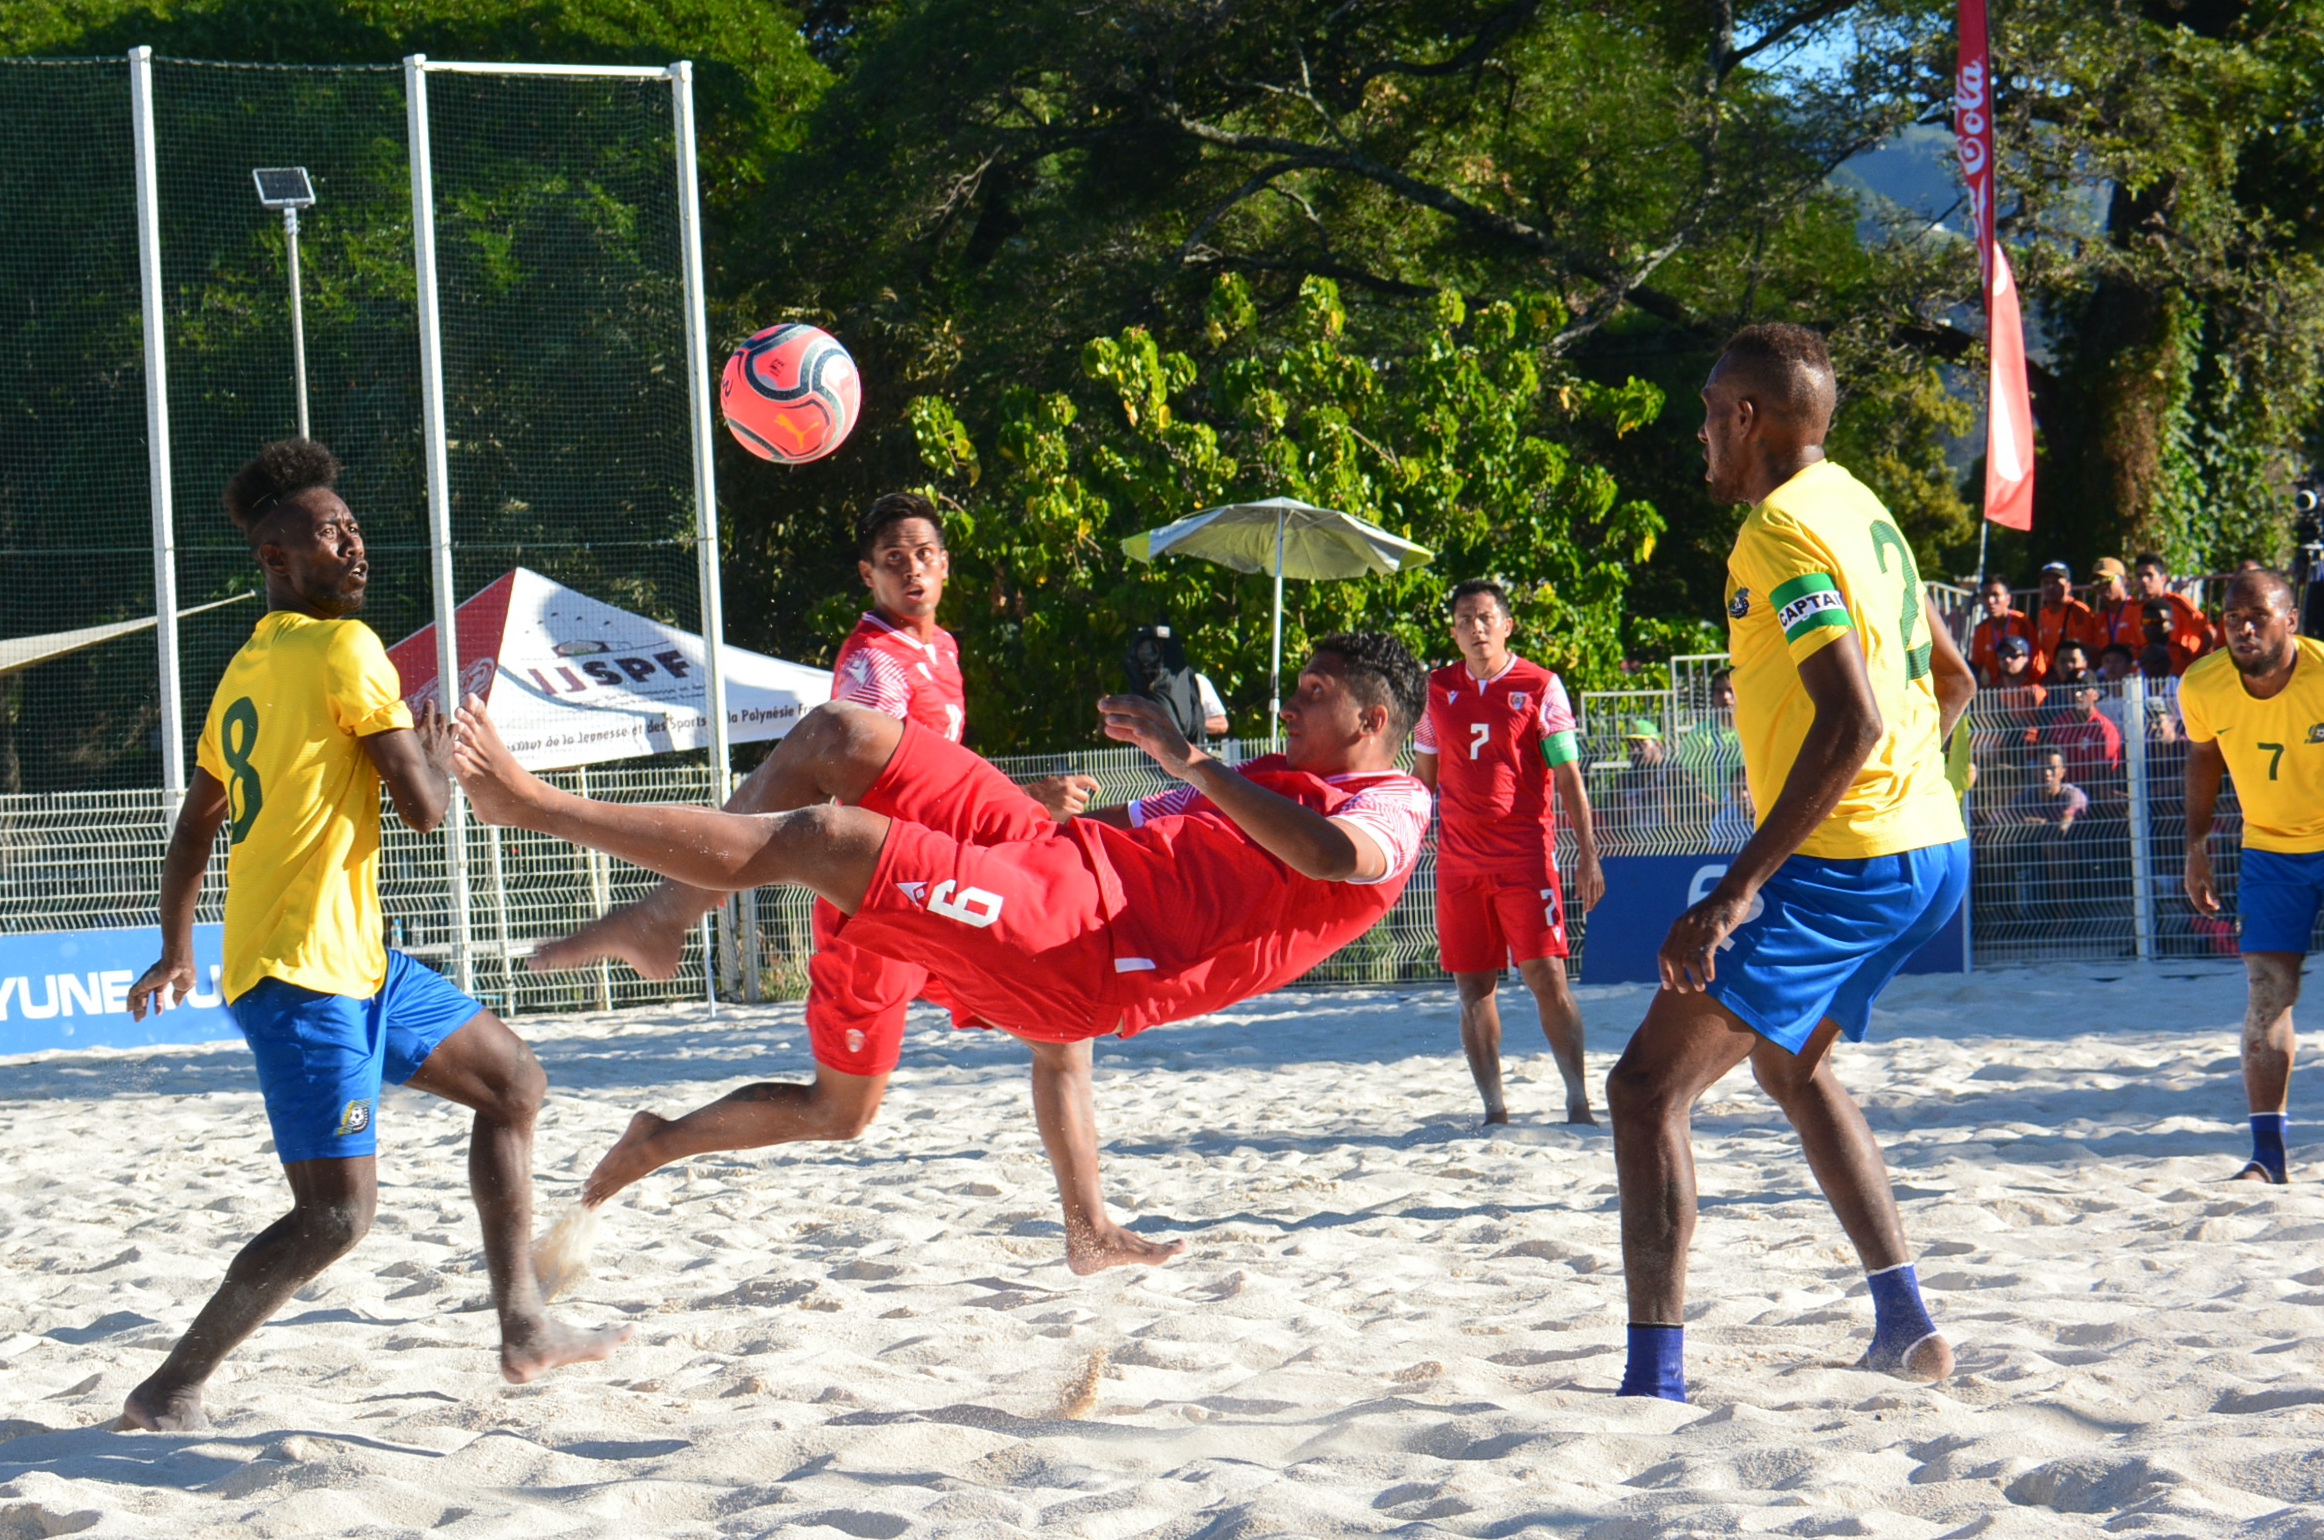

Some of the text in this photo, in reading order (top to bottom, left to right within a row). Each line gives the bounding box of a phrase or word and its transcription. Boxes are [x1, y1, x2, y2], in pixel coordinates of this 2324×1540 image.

[1869, 519, 1931, 690] 2
[527, 650, 690, 695] IJSPF
[647, 719, 667, 733] des
[671, 716, 707, 733] Sports
[1470, 723, 1490, 760] 7
[221, 696, 263, 845] 8
[2257, 742, 2285, 781] 7
